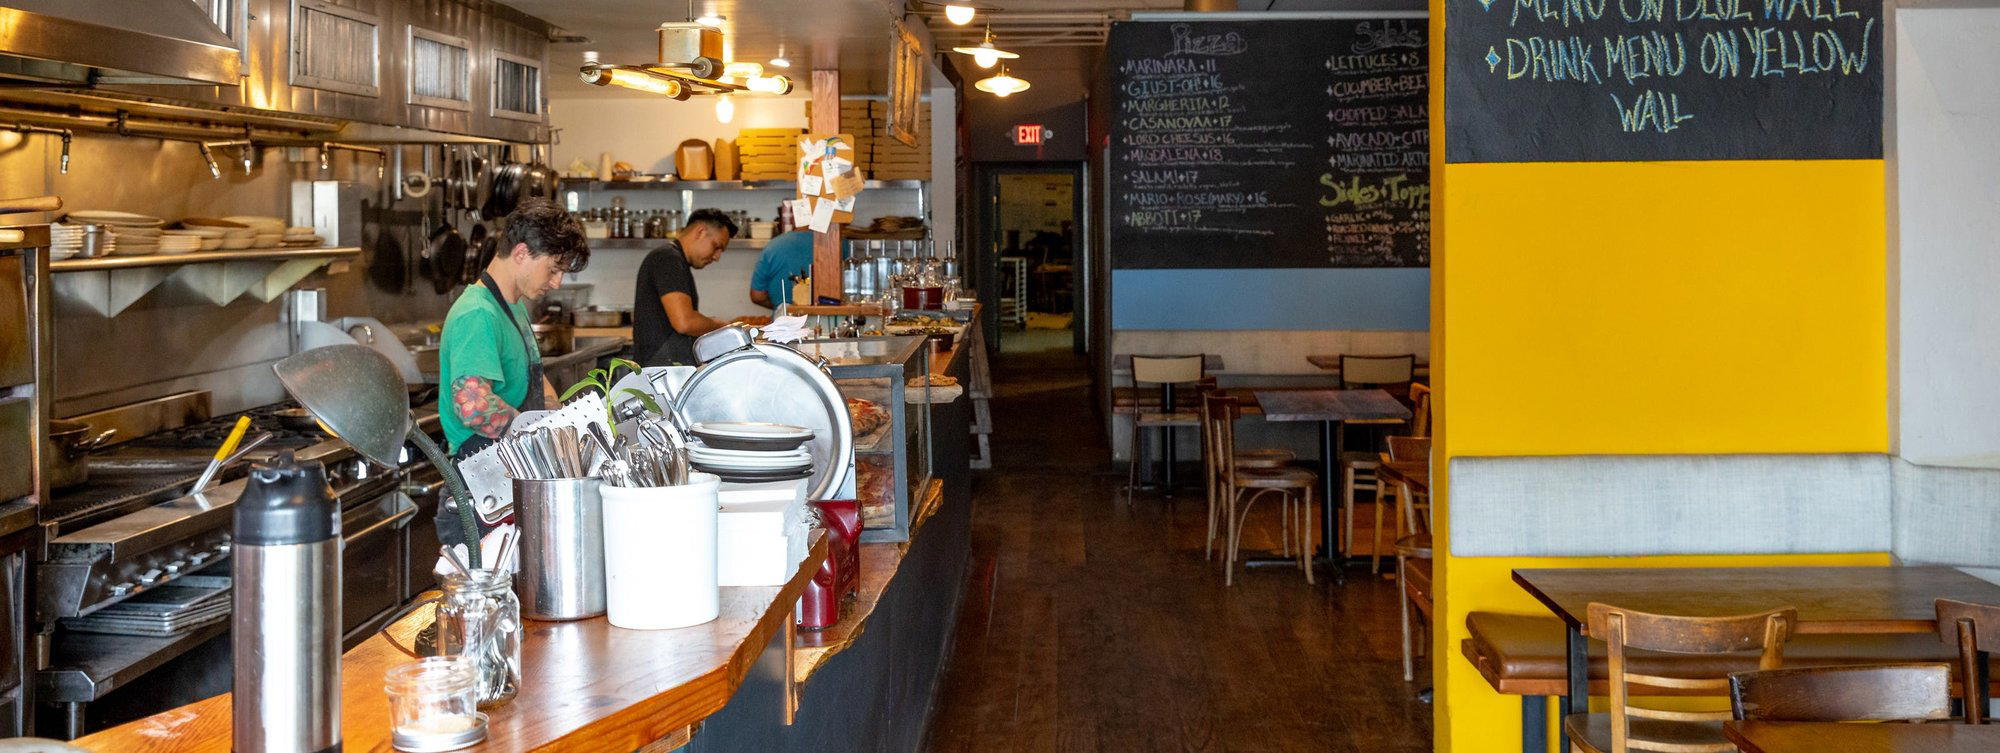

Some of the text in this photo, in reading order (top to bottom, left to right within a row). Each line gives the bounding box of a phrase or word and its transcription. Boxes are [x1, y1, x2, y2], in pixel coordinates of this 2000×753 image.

[1506, 17, 1875, 86] DRINK MENU ON YELLOW
[1125, 59, 1196, 74] MARINARA
[1127, 97, 1210, 113] MARGHERITA
[1610, 89, 1695, 133] WALL
[1220, 115, 1232, 127] 17
[1018, 125, 1041, 144] EXIT
[1128, 133, 1160, 146] LORD
[1129, 192, 1168, 206] MARIO
